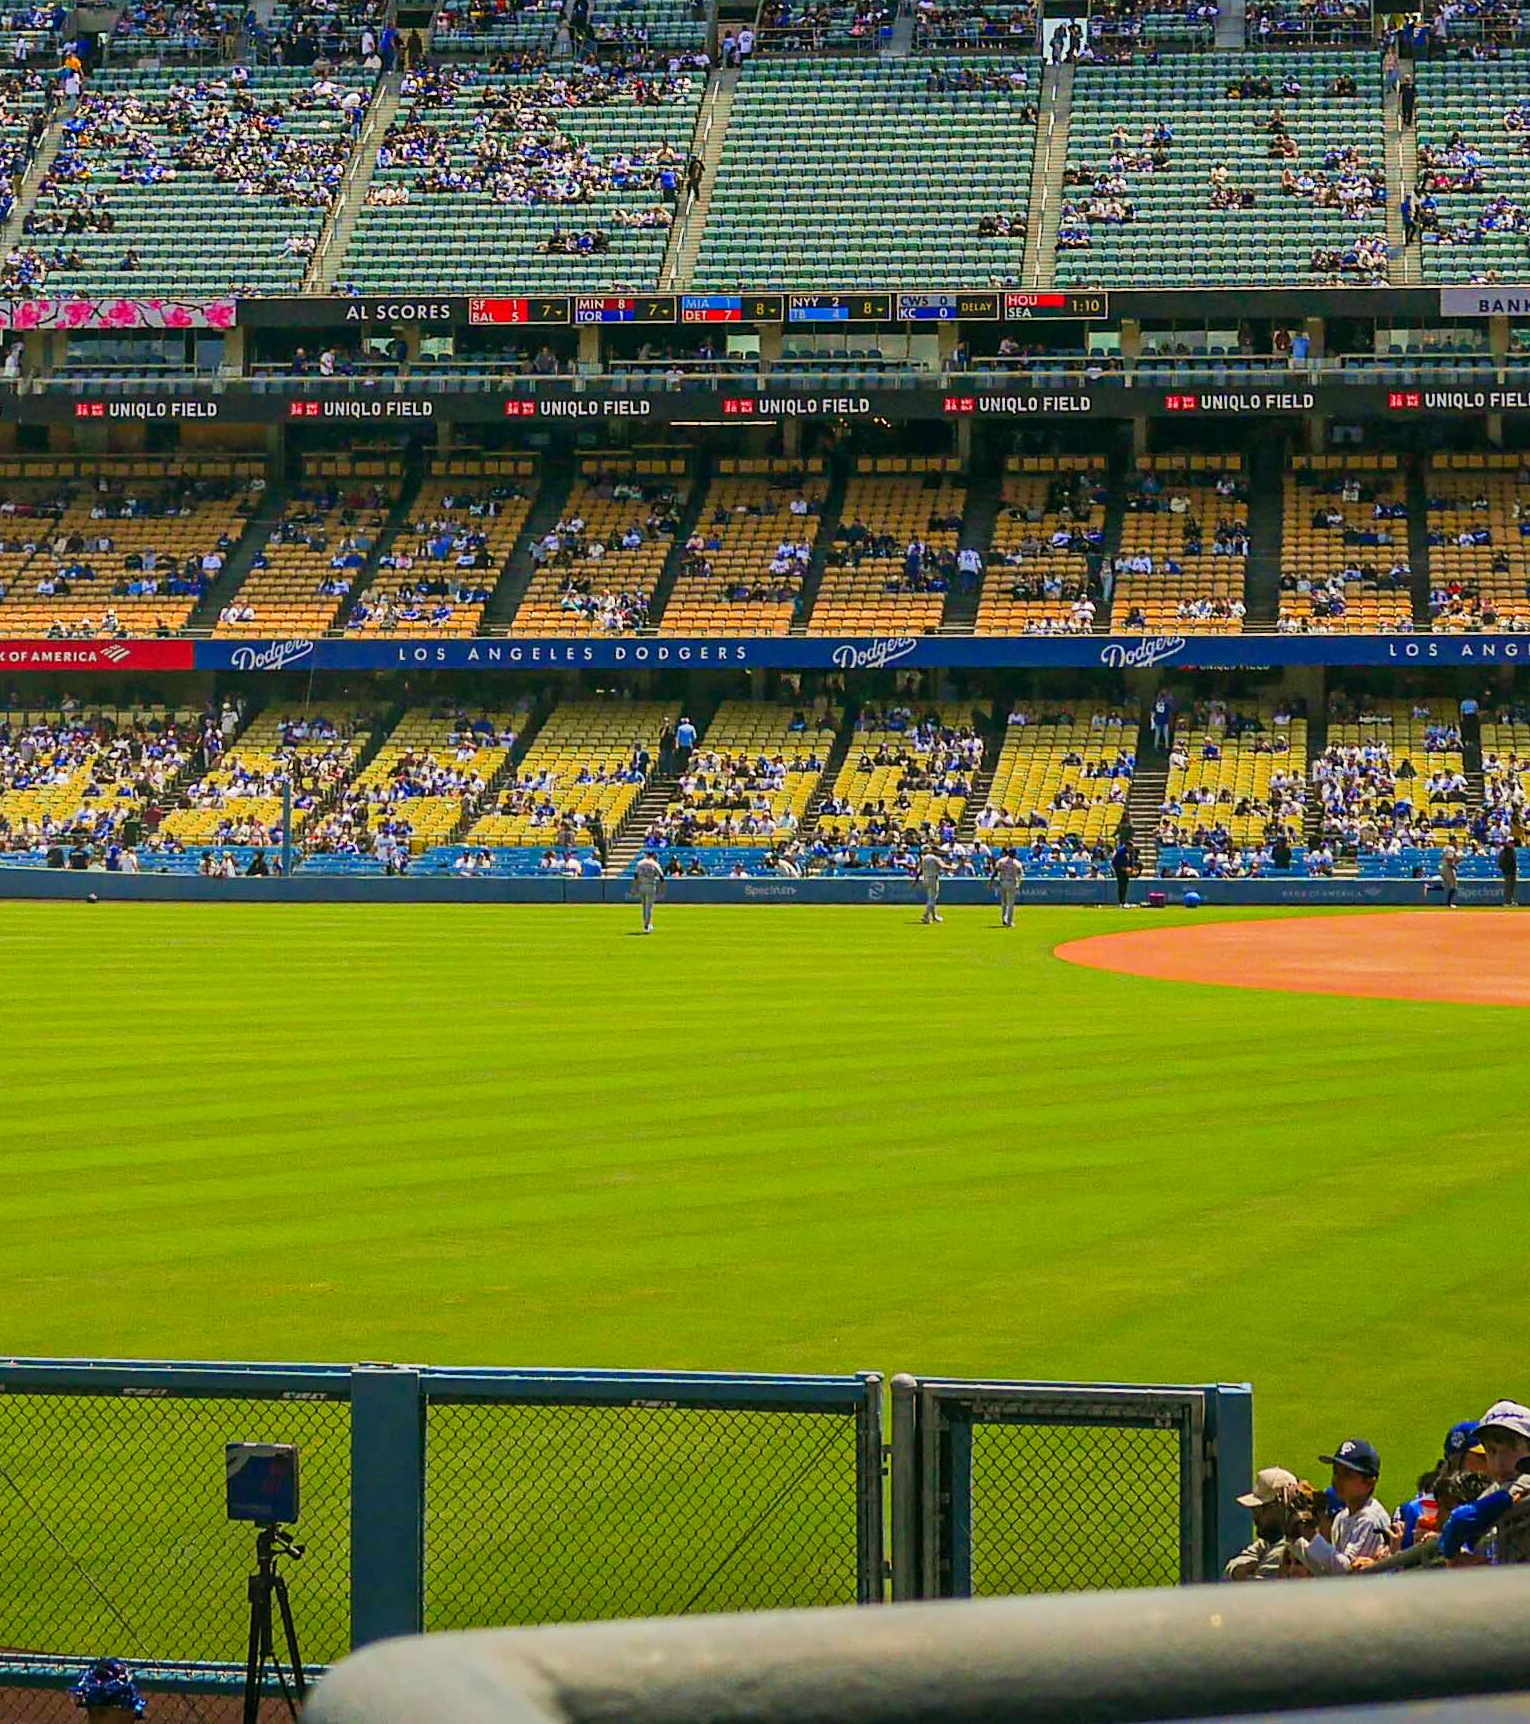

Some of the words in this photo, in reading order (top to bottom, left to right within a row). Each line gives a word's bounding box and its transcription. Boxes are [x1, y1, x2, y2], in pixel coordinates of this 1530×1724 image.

[472, 300, 486, 310] SF
[512, 300, 518, 310] 1
[579, 299, 605, 310] MIN
[617, 299, 626, 310] 8
[686, 298, 710, 308] MIA
[792, 297, 819, 307] NYY
[831, 297, 840, 307] 2
[1007, 295, 1038, 306] HOU
[1072, 300, 1100, 312] 1:10
[346, 305, 370, 321] AL
[375, 305, 451, 321] SCORES
[542, 305, 551, 315] 7
[648, 304, 657, 316] 7
[756, 303, 764, 315] 8
[863, 302, 872, 314] 8
[899, 307, 916, 318] KC
[939, 307, 948, 318] 0
[961, 302, 992, 312] DELAY
[1007, 307, 1032, 318] SEA
[472, 312, 494, 321] BAL
[577, 311, 603, 321] TOR
[685, 310, 709, 321] DET
[724, 310, 732, 320] 7
[759, 399, 817, 415] UNIQLO
[822, 399, 870, 413] FIELD
[979, 397, 1038, 413] UNIQLO
[1043, 397, 1091, 411] FIELD
[1201, 395, 1261, 411] UNIQLO
[1265, 394, 1314, 409] FIELD
[1425, 393, 1485, 409] UNIQLO
[109, 403, 166, 419] UNIQLO
[171, 403, 217, 417] FIELD
[324, 402, 381, 418] UNIQLO
[386, 402, 433, 416] FIELD
[540, 401, 598, 417] UNIQLO
[603, 400, 650, 415] FIELD
[231, 639, 314, 670] Dodgers
[399, 647, 445, 661] LOS
[468, 647, 592, 661] ANGELES
[615, 646, 746, 660] DODGERS
[832, 637, 917, 667] Dodgers
[1100, 636, 1186, 667] Dodgers
[1389, 643, 1438, 657] LOS
[9, 650, 28, 663] OF
[31, 650, 98, 663] AMERICA
